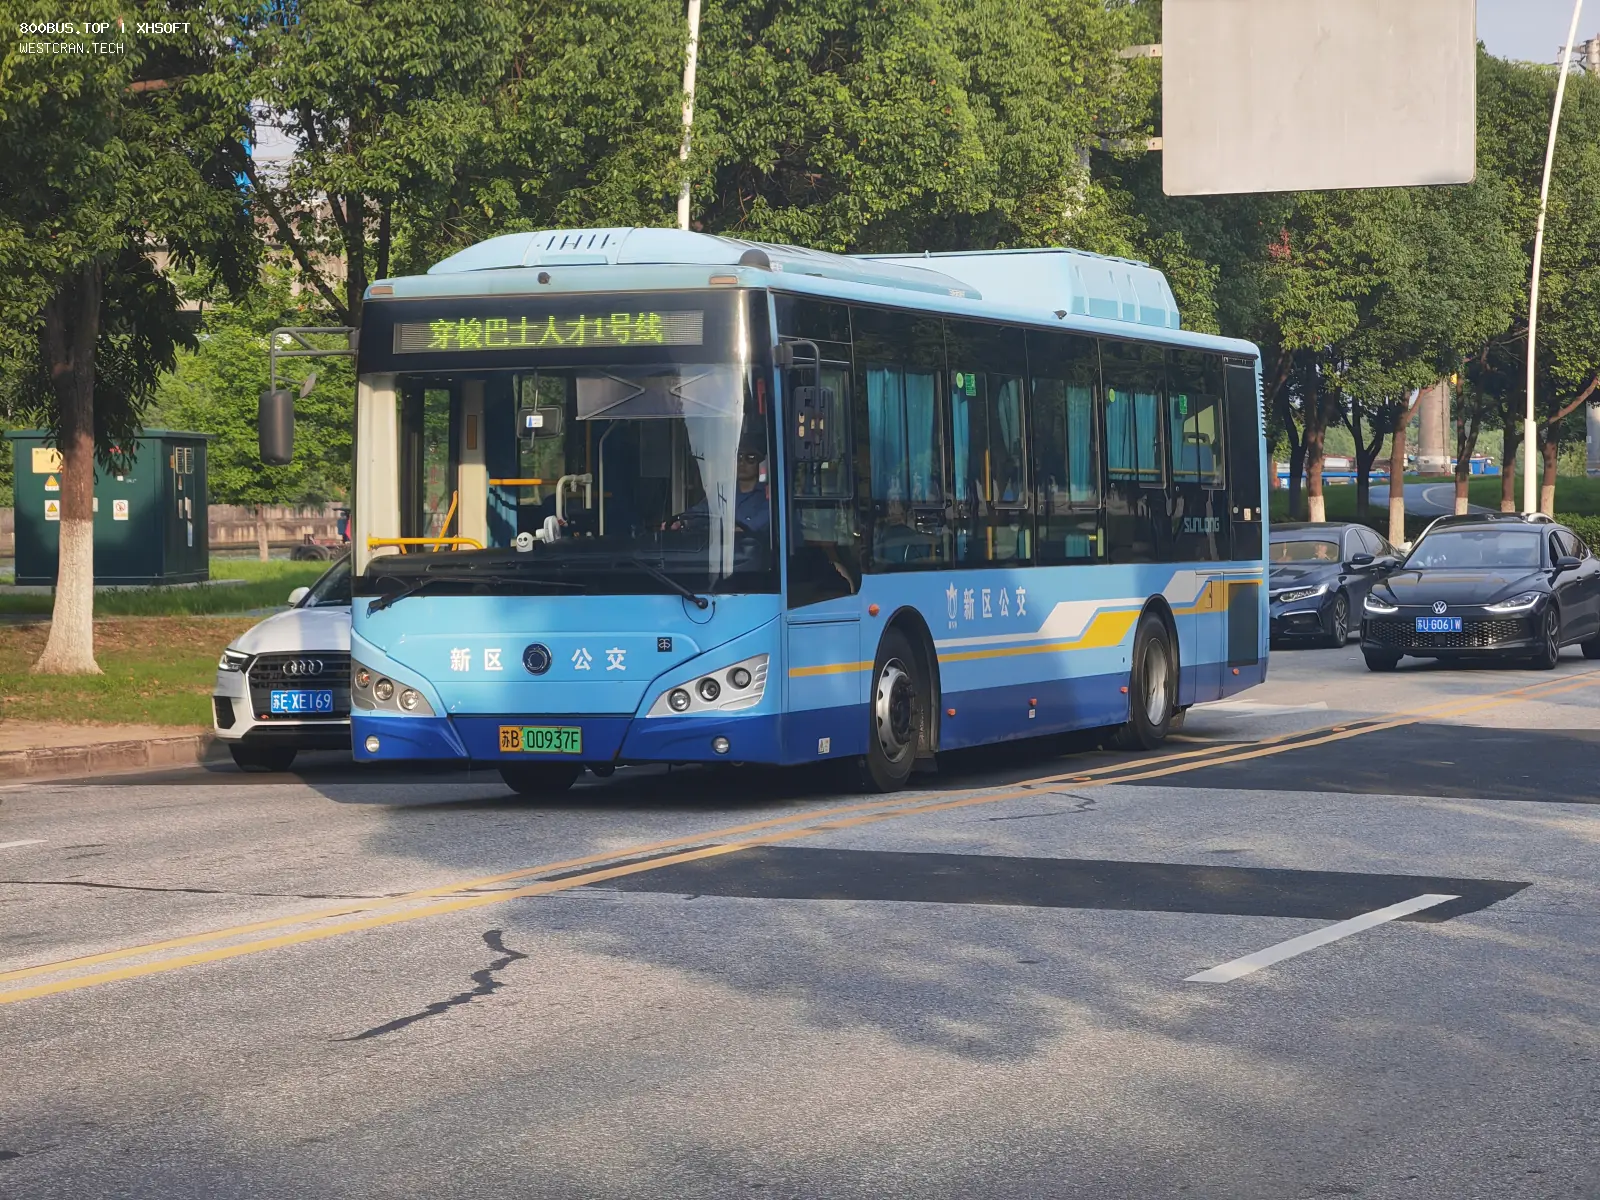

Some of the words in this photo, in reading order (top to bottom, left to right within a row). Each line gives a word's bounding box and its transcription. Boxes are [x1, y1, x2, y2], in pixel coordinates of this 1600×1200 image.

[427, 312, 663, 349] 穿梭巴士人才1号线
[1184, 517, 1219, 532] SUNLONG
[963, 586, 1026, 620] 新区公交
